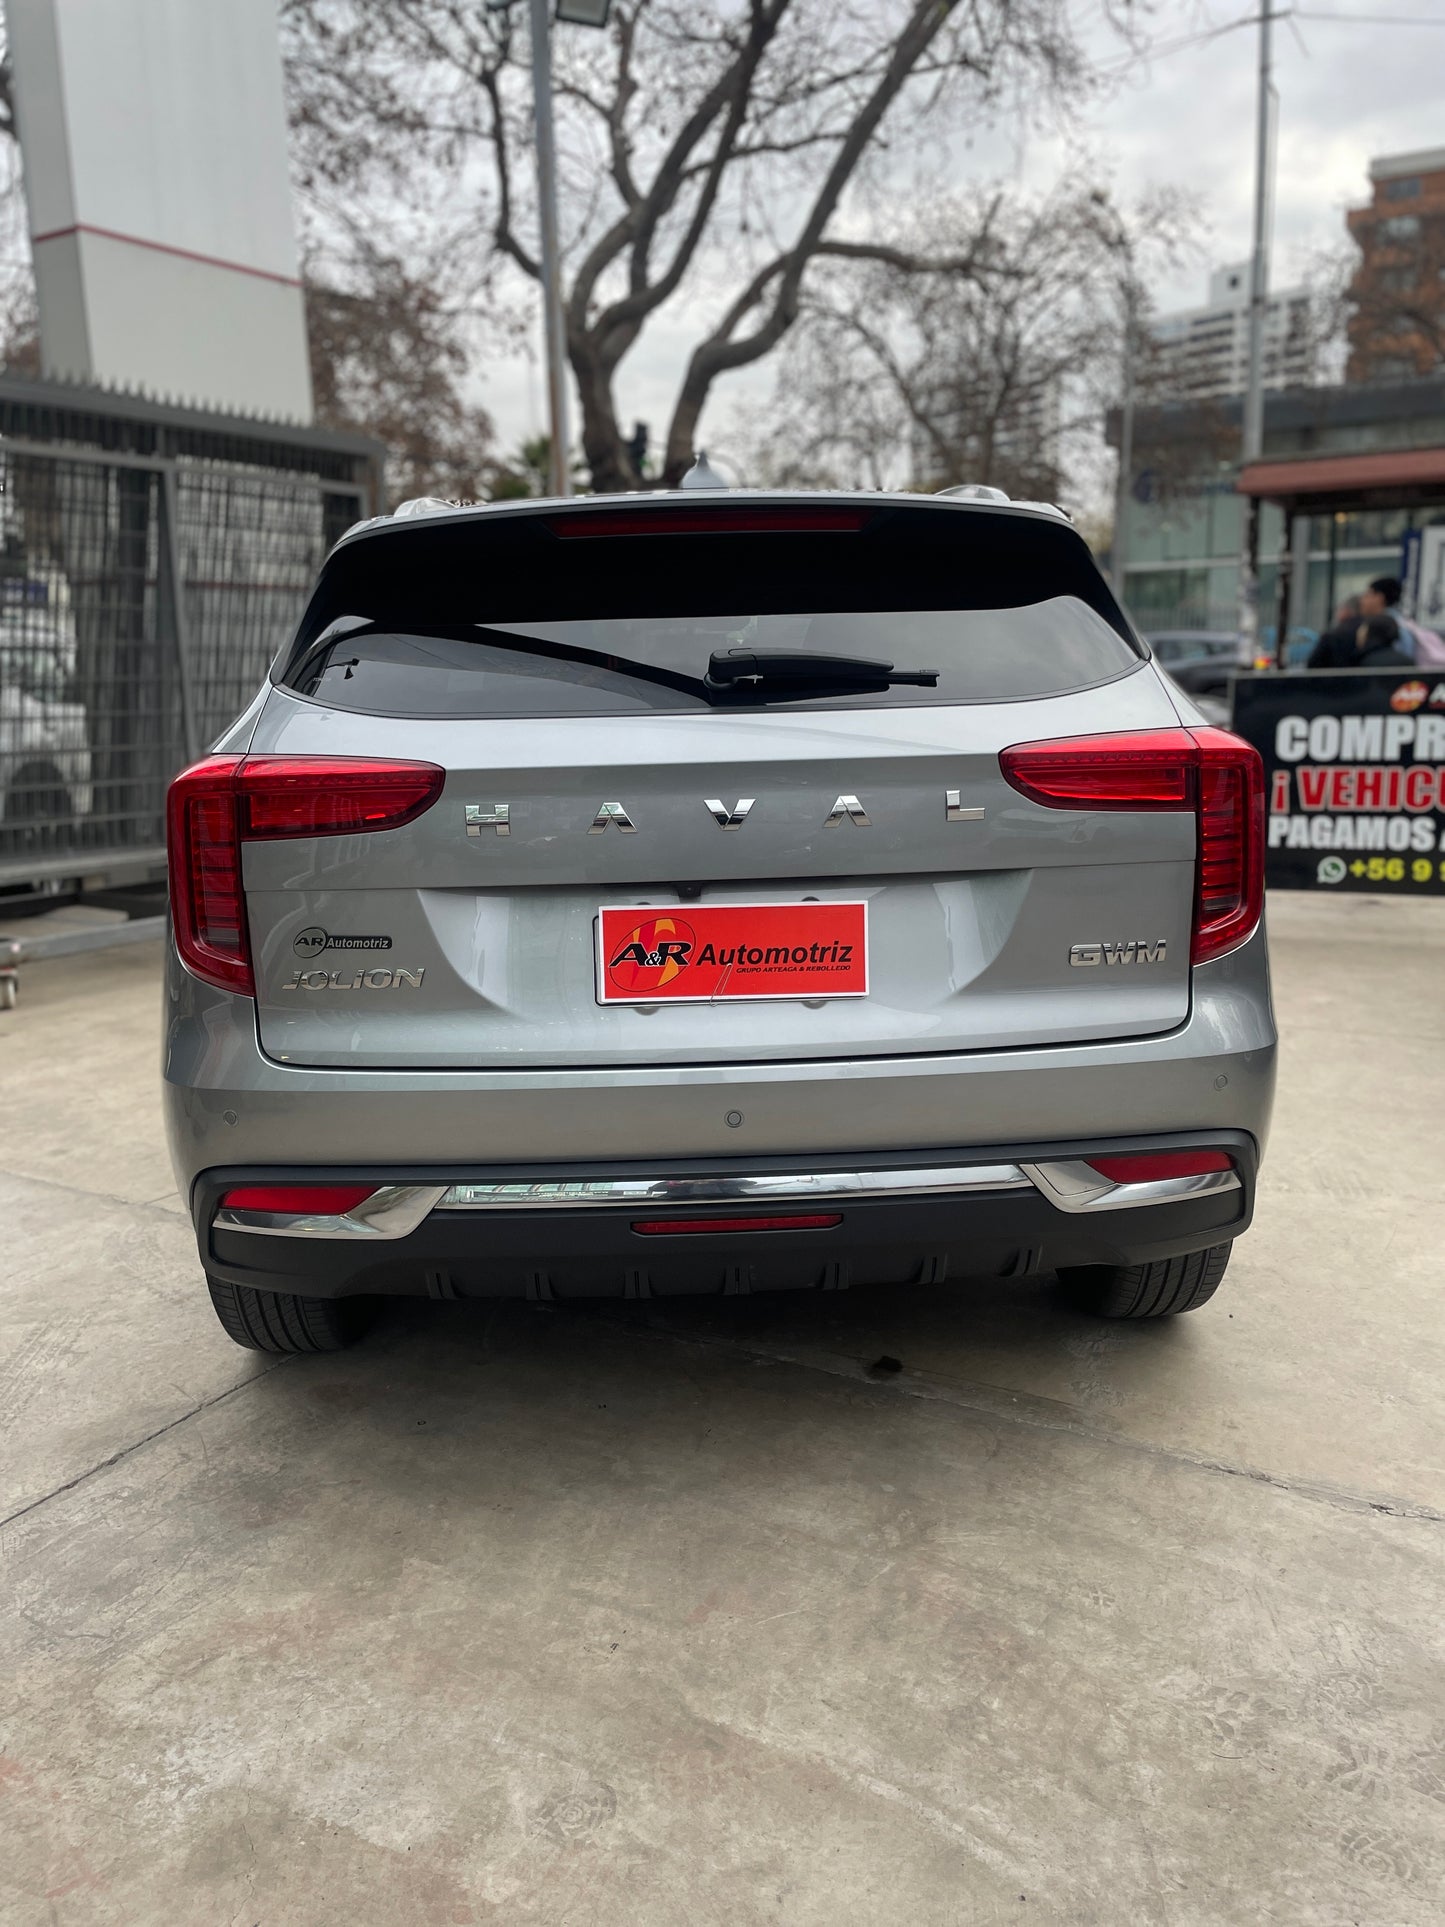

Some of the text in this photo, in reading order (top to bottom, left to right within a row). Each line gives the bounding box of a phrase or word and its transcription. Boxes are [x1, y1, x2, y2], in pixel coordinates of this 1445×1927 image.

[464, 789, 985, 837] HAVAL
[1267, 815, 1437, 852] PAGAMOS
[1350, 857, 1405, 881] +56
[1411, 858, 1433, 882] 9
[326, 937, 389, 949] Automotriz
[608, 940, 854, 967] A&R Automotriz
[1070, 939, 1167, 967] GWM
